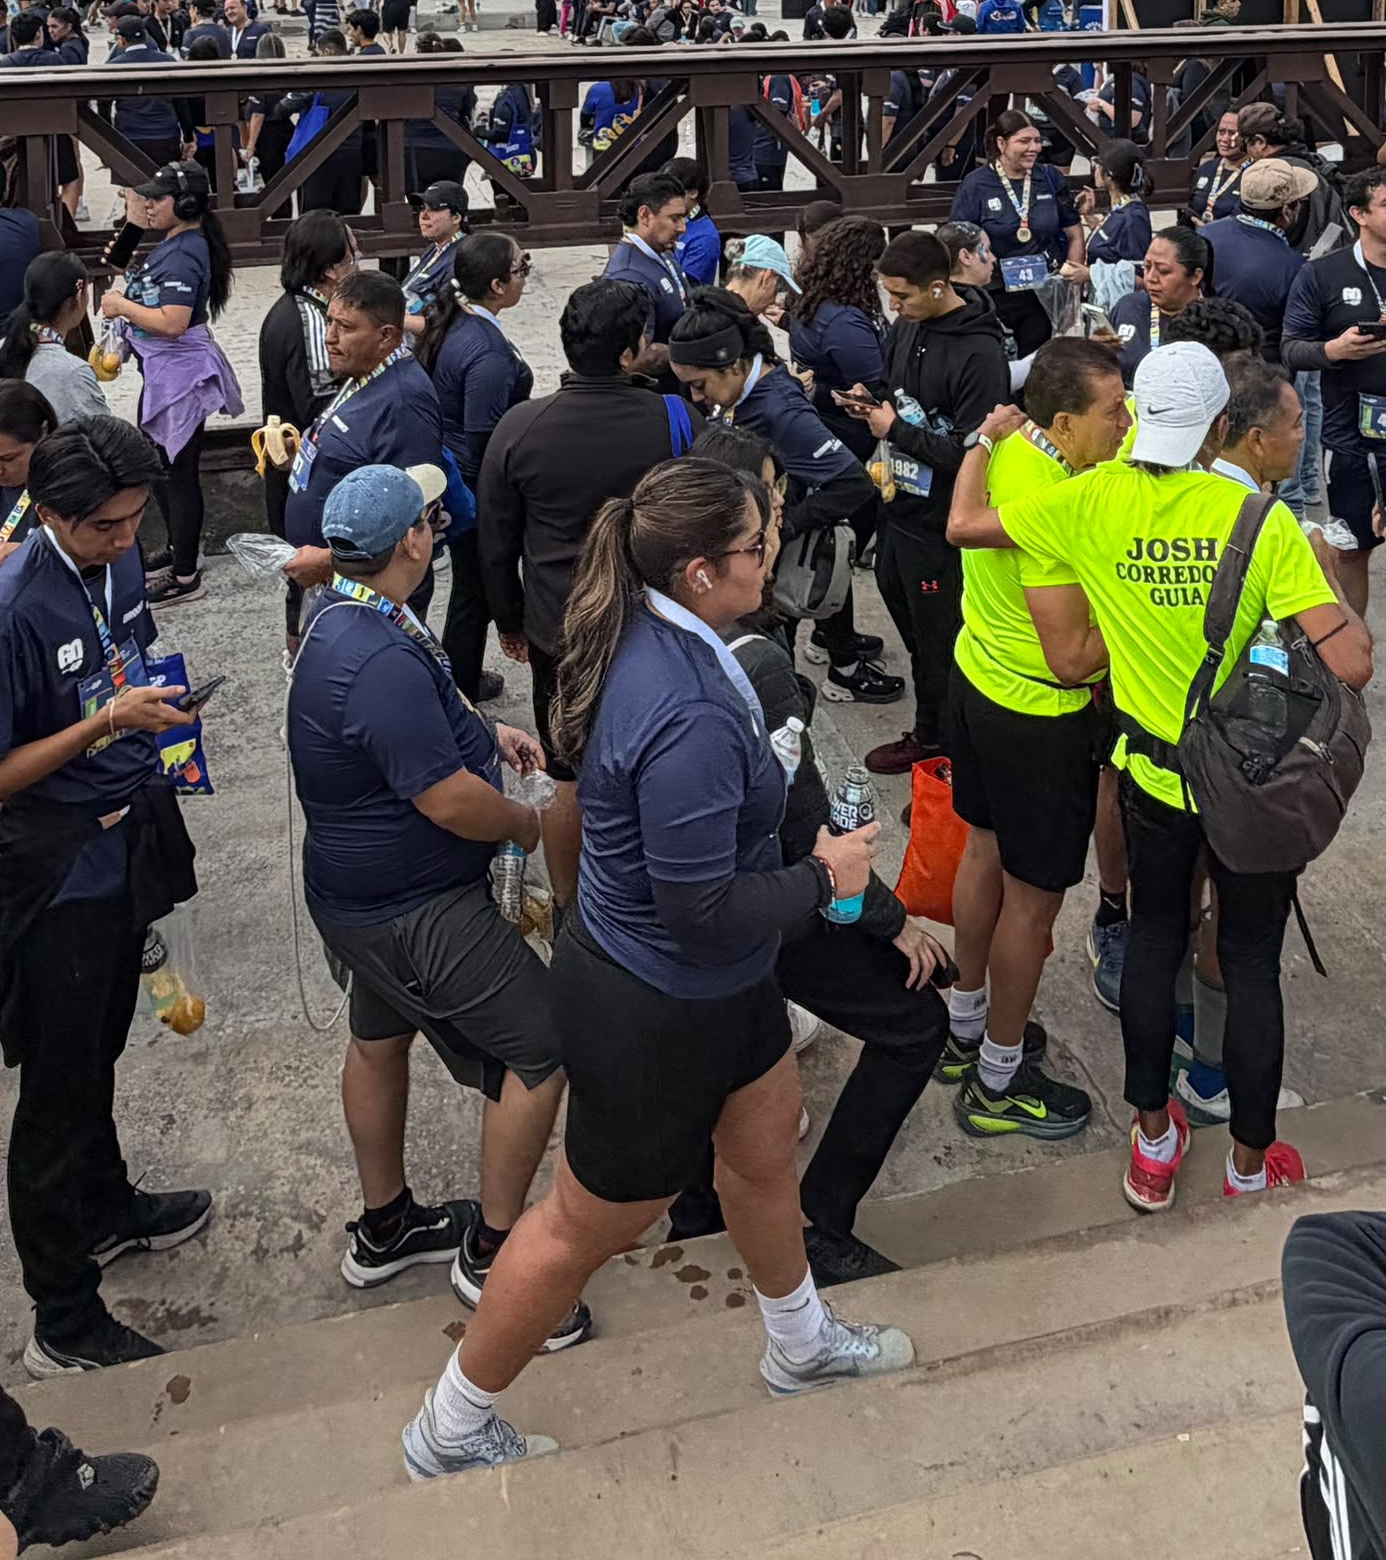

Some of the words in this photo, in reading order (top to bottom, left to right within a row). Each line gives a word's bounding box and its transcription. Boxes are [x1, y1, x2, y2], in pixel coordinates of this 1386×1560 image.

[1019, 268, 1033, 281] 43
[889, 457, 919, 480] 1982
[1126, 537, 1218, 562] JOSH
[1149, 587, 1205, 607] GUIA
